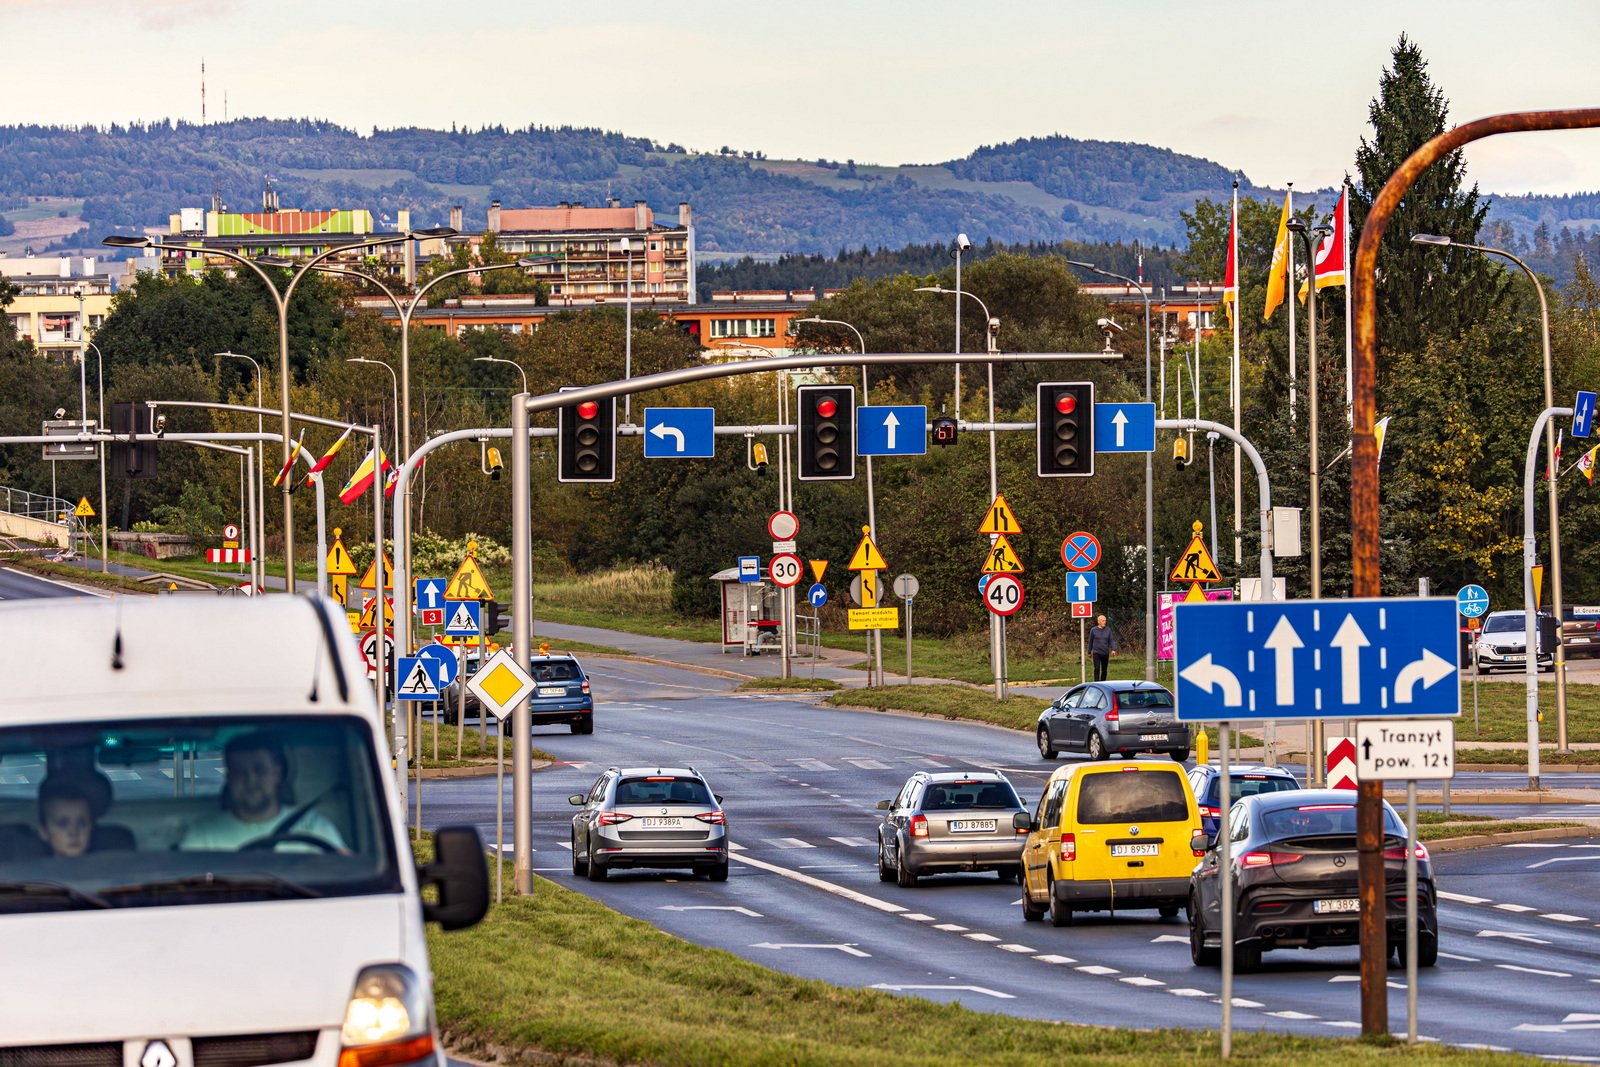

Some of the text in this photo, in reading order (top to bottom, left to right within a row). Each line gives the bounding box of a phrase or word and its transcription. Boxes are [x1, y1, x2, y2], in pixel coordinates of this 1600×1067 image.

[938, 425, 954, 439] 67
[775, 562, 797, 577] 30
[990, 584, 1019, 605] 40
[1078, 605, 1085, 615] 3
[429, 612, 436, 622] 3
[1380, 728, 1441, 746] Tranzyt
[1375, 758, 1415, 772] pow.
[646, 818, 681, 826] DJ 9389A
[958, 820, 994, 829] DJ 87885
[1117, 844, 1156, 854] DJ 89571
[1321, 900, 1333, 910] PY
